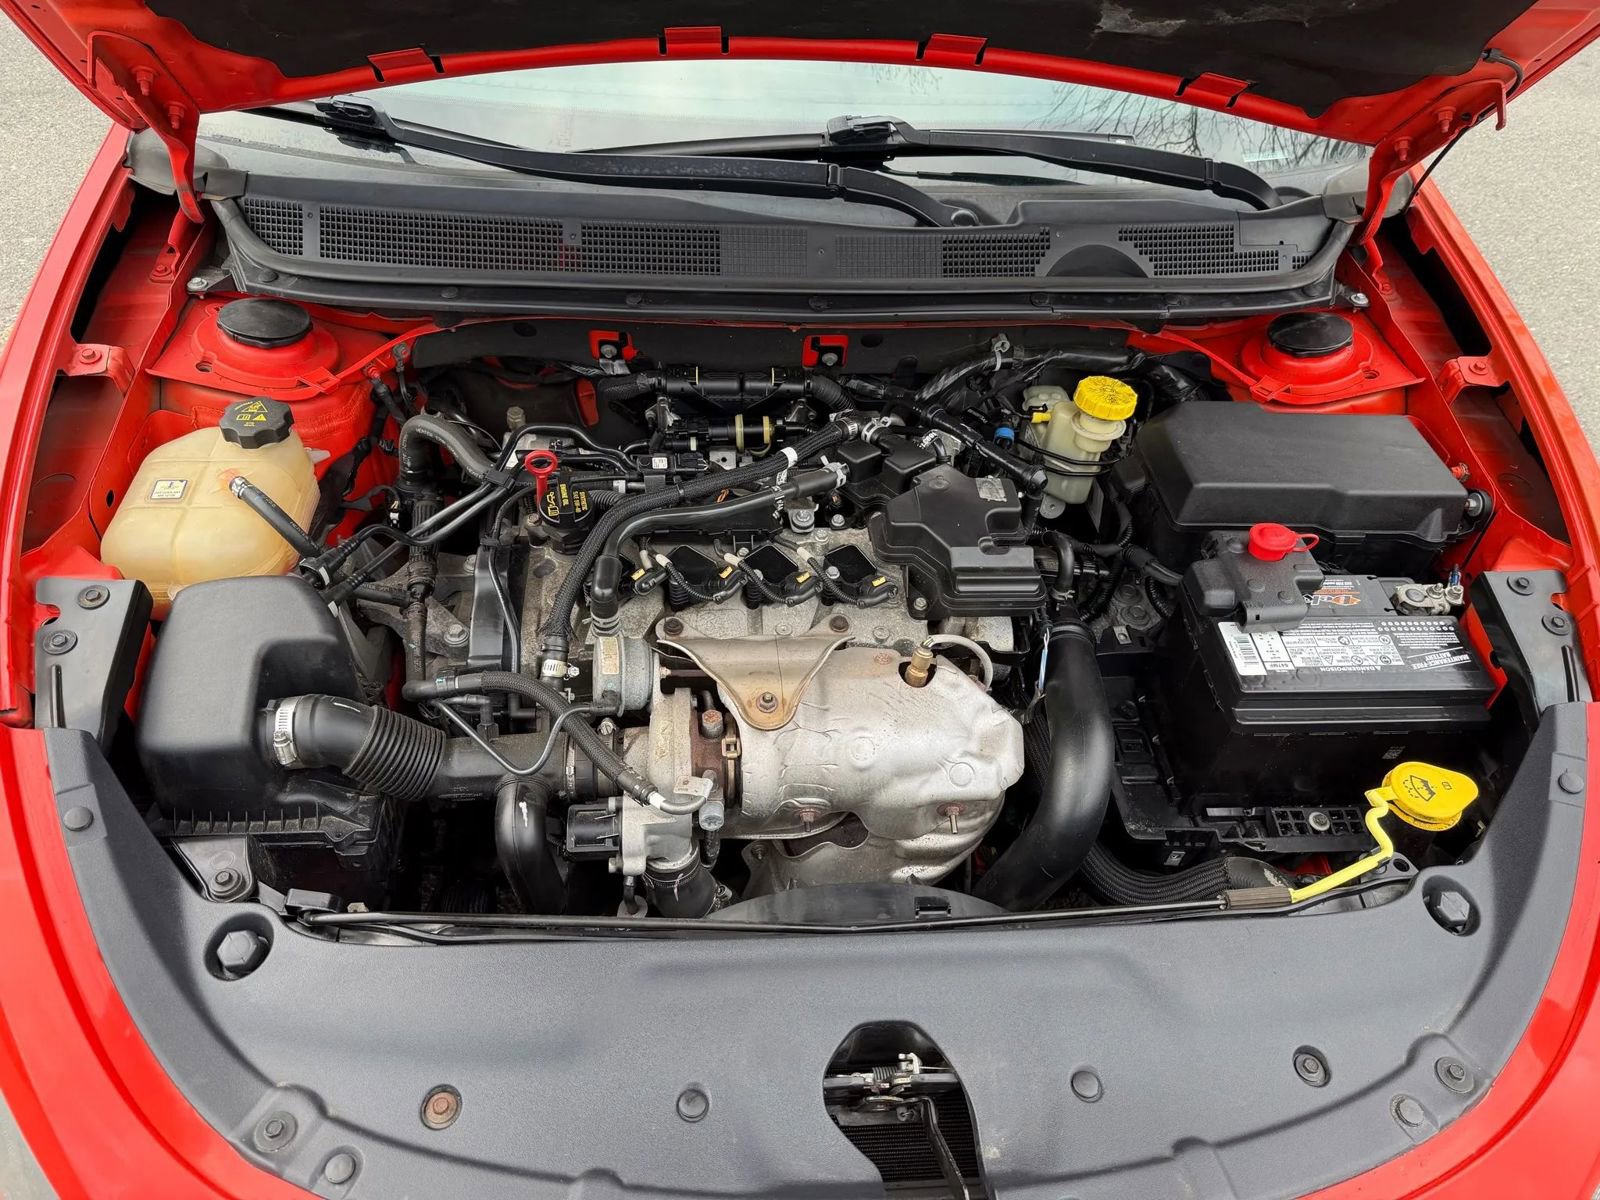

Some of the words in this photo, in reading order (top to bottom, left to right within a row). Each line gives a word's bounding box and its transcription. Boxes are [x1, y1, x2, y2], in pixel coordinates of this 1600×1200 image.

[559, 483, 569, 498] ENGINE
[562, 498, 570, 507] OIL
[1411, 653, 1470, 670] MAINTENANCE-FREE
[1424, 651, 1452, 662] BATTERY
